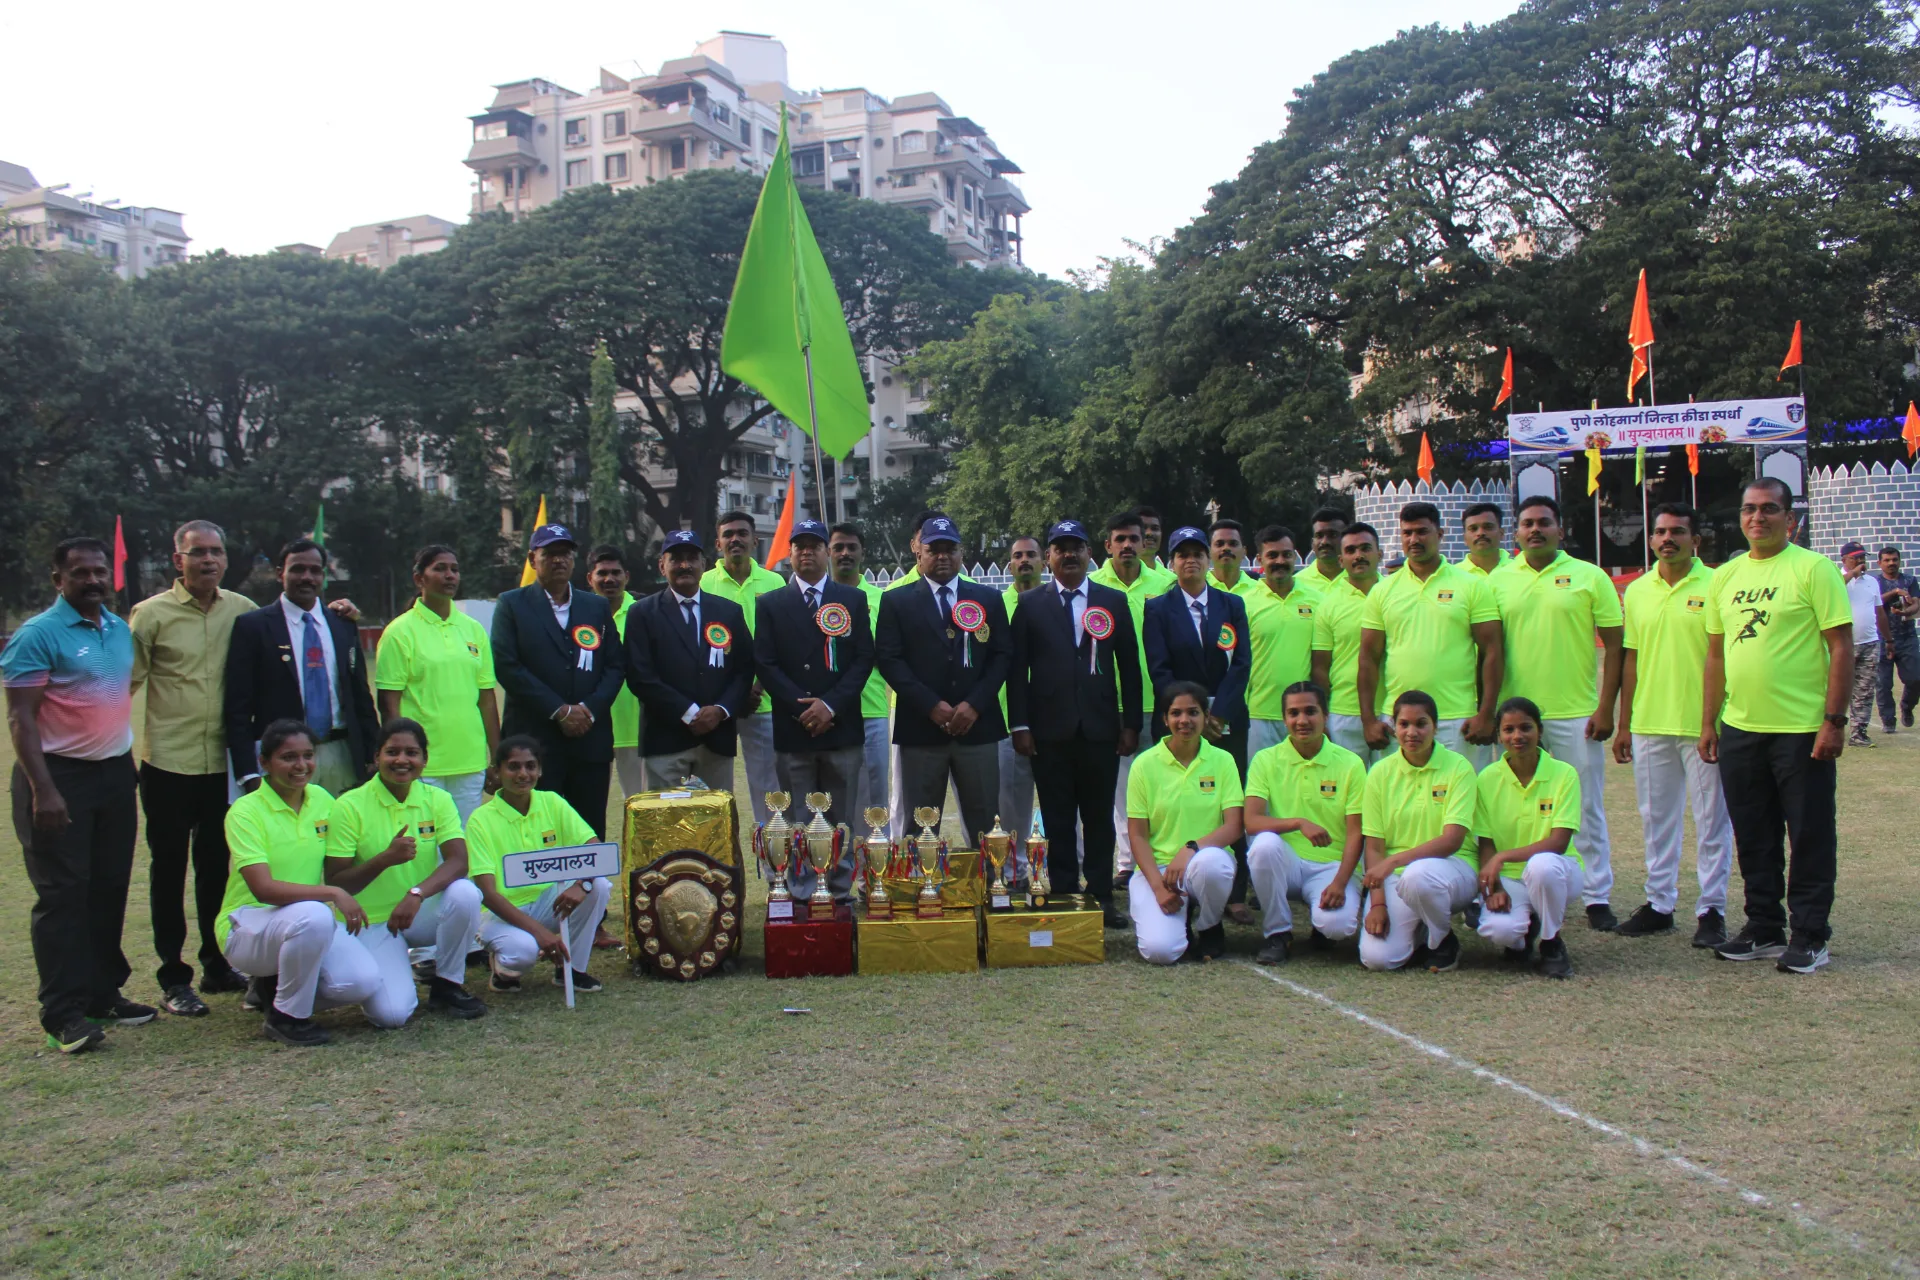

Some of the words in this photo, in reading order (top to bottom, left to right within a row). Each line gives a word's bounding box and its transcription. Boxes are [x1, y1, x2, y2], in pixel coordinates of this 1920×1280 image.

[1570, 414, 1591, 431] पुणे
[1593, 411, 1644, 427] लोहमार्ग
[1645, 410, 1679, 424] जिल्हा
[1681, 408, 1709, 423] क्रीडा
[1711, 406, 1743, 420] स्पर्धा
[1731, 587, 1779, 606] RUN
[523, 852, 598, 879] मुख्यालय
